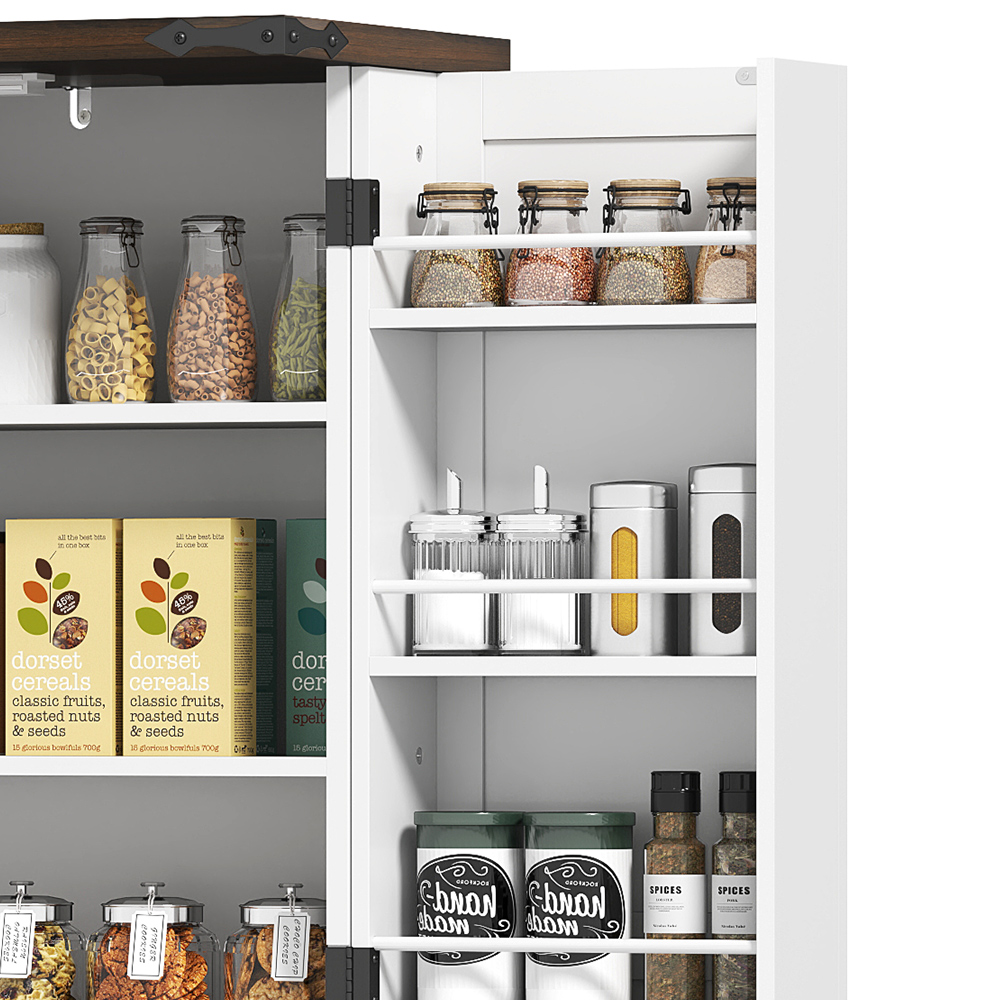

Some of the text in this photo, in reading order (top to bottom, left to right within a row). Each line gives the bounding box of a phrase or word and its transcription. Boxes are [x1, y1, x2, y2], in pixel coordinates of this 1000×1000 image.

[11, 651, 82, 669] dorset
[129, 651, 200, 669] dorset
[11, 672, 91, 691] cereals
[129, 672, 209, 691] cereals
[12, 695, 105, 709] classic fruits,
[130, 695, 224, 709] classic fruits,
[292, 696, 326, 710] tasty
[12, 710, 101, 722] roasted nuts
[130, 710, 219, 722] roasted nuts
[293, 711, 326, 726] spelt
[12, 725, 66, 737] & seeds
[130, 725, 184, 737] & seeds
[21, 744, 50, 752] glorious
[83, 744, 101, 752] 700g
[649, 885, 682, 894] SPICES
[718, 886, 750, 895] SPICES
[281, 925, 290, 965] COOKIES
